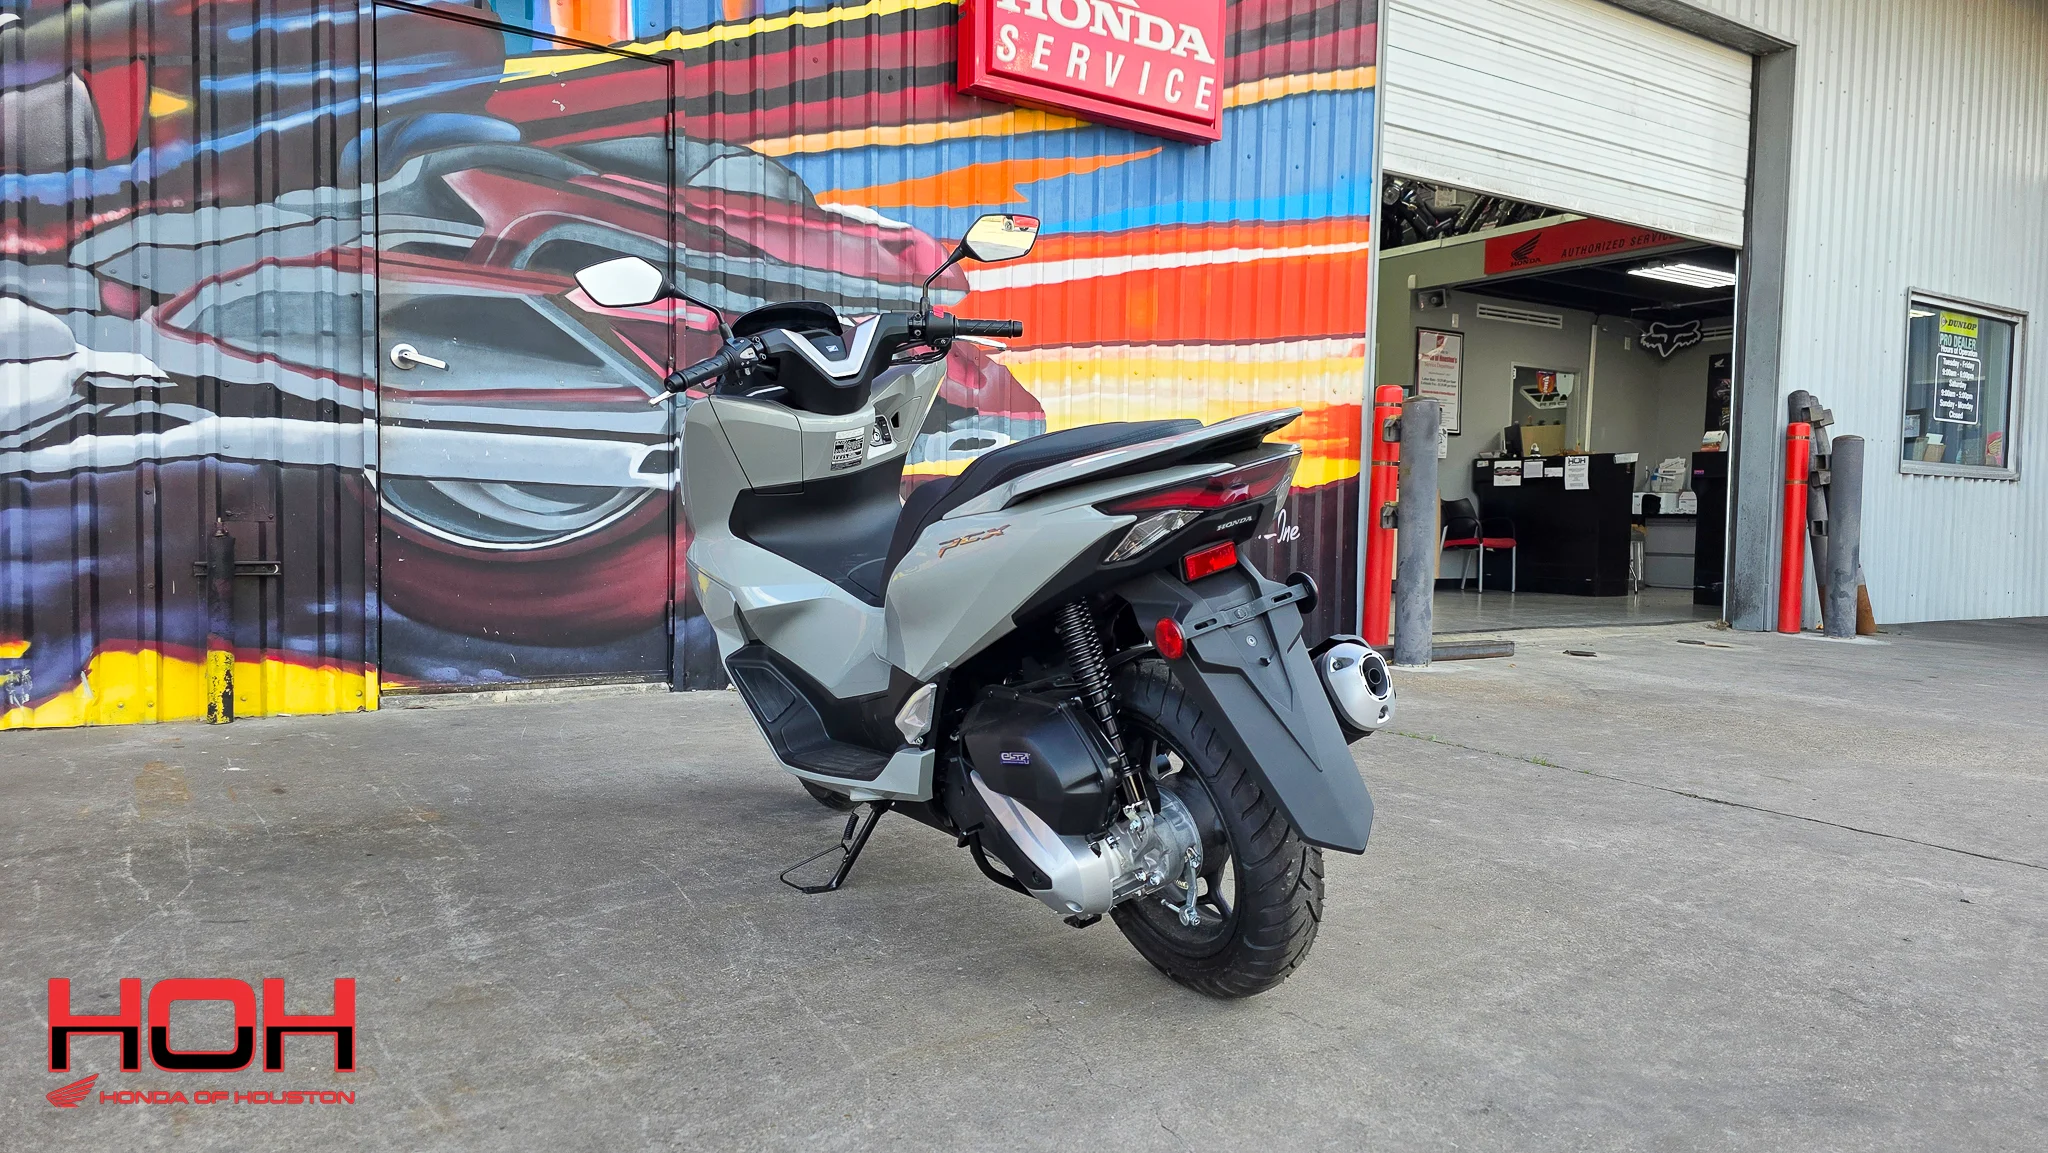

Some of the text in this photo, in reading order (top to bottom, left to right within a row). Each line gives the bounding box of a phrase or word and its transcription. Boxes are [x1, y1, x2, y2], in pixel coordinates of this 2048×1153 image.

[996, 24, 1215, 112] SERVICE
[1561, 232, 1674, 258] AUTHORIZED SERVIC
[1510, 258, 1542, 268] HONDA
[1948, 319, 1977, 331] DUNLOP
[1940, 333, 1976, 350] PRO DEALER
[1943, 357, 1960, 369] Tuesday
[1962, 360, 1975, 371] Friday
[1948, 379, 1967, 390] Saturday
[1939, 399, 1955, 409] Sunday
[1957, 401, 1973, 412] Monday
[1948, 410, 1963, 419] Closed
[1216, 515, 1252, 532] HONDA
[937, 524, 1011, 559] PCX
